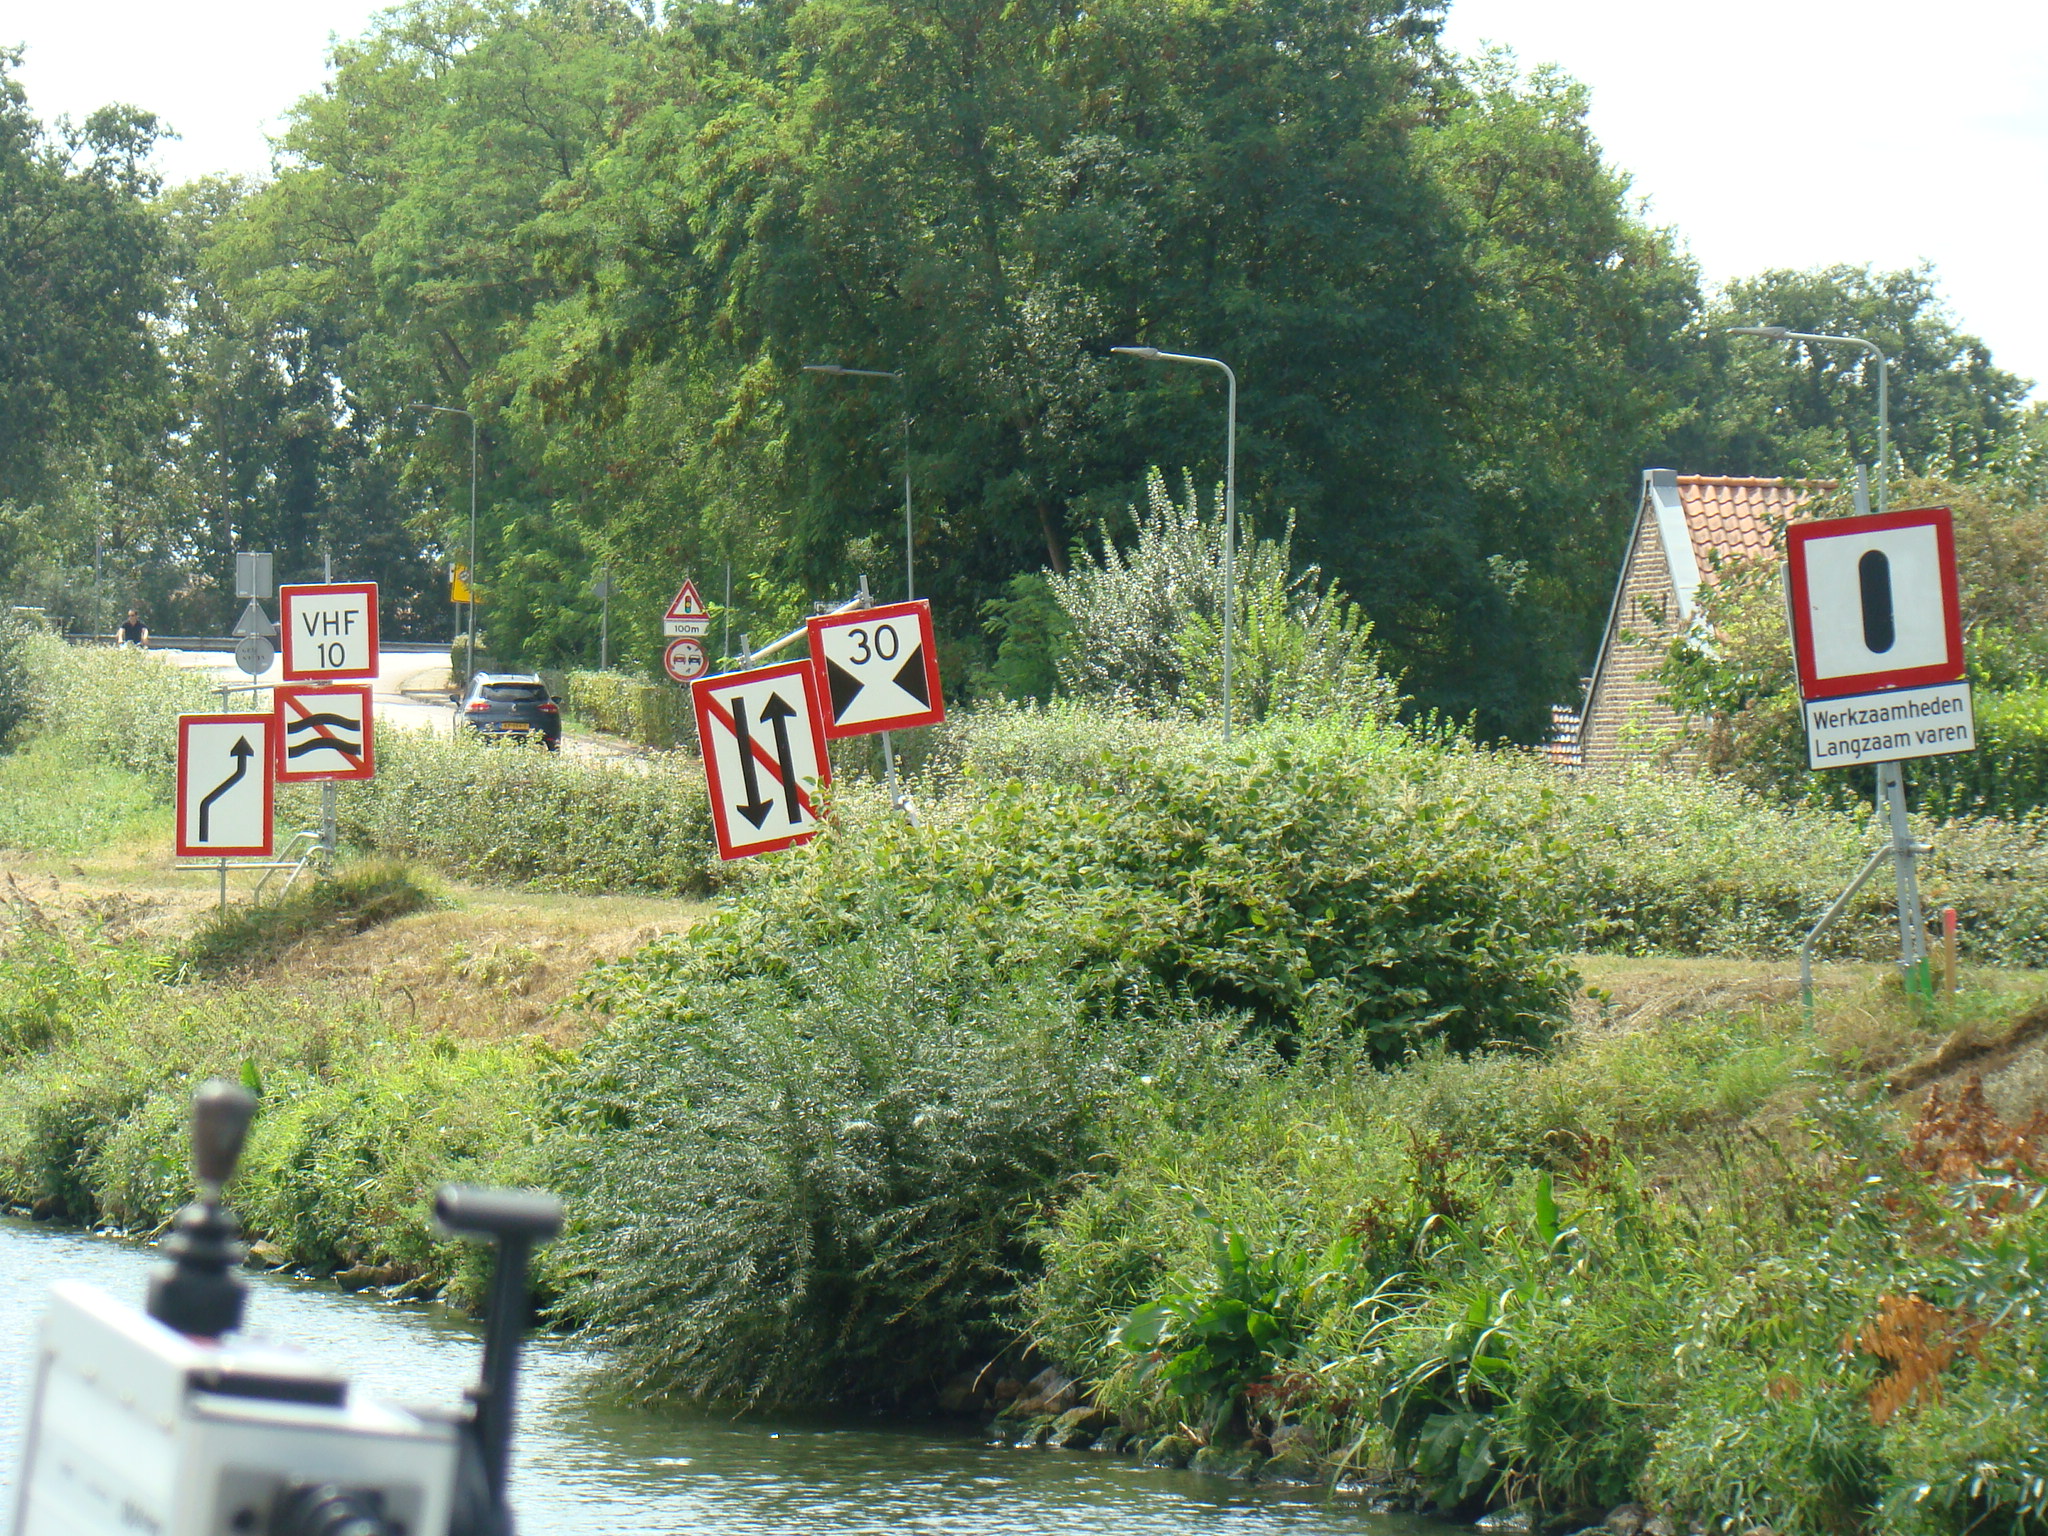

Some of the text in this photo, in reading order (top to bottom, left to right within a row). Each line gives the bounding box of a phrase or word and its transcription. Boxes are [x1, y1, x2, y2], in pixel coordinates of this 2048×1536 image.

[302, 610, 359, 637] VHF
[674, 624, 700, 634] 100m
[317, 642, 346, 669] 10
[848, 624, 899, 666] 30
[1813, 696, 1964, 731] Werkzaamheden
[1815, 724, 1968, 759] Langzaam varen
